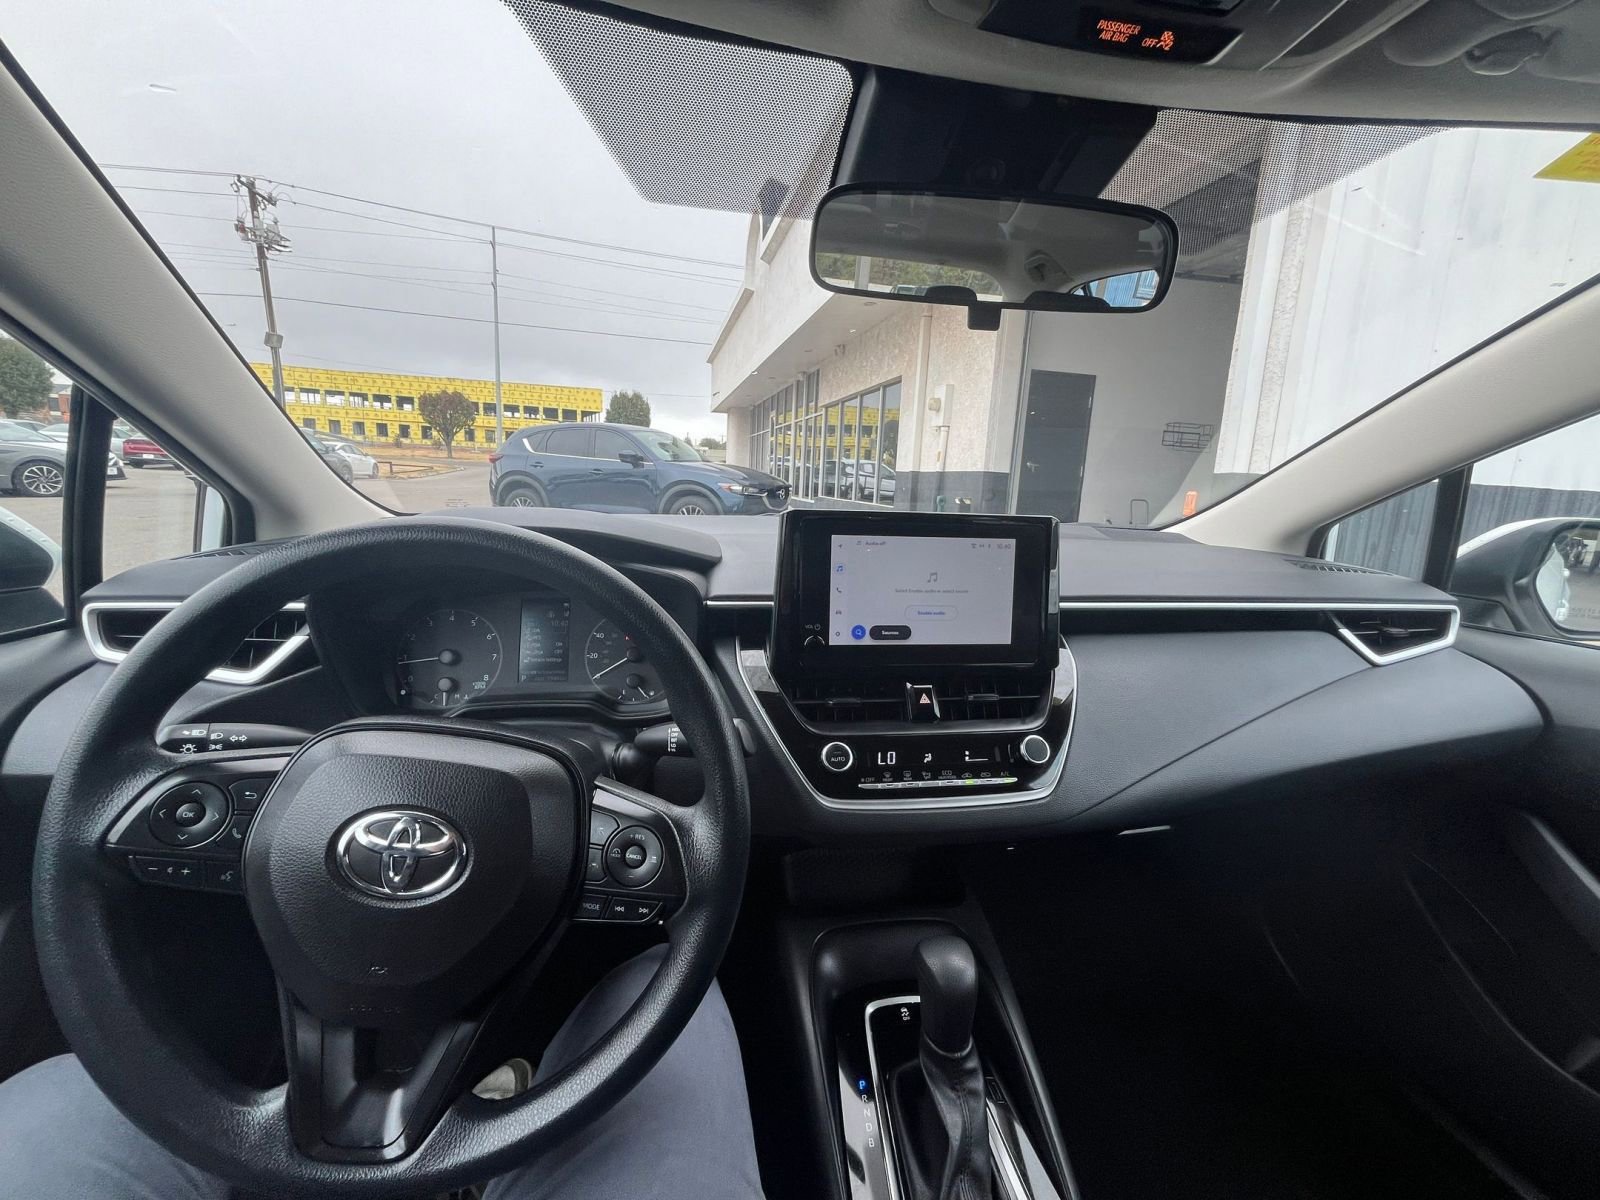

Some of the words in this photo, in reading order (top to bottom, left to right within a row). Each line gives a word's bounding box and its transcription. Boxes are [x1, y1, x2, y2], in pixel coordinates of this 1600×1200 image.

[1097, 20, 1141, 35] PASSENGER
[1099, 31, 1111, 41] AIR
[1112, 32, 1130, 43] BAG
[1141, 38, 1158, 48] OFF
[877, 751, 896, 765] LO
[182, 811, 195, 819] OK
[626, 852, 642, 860] CANCEL
[582, 901, 600, 911] MODE
[859, 1080, 866, 1089] P
